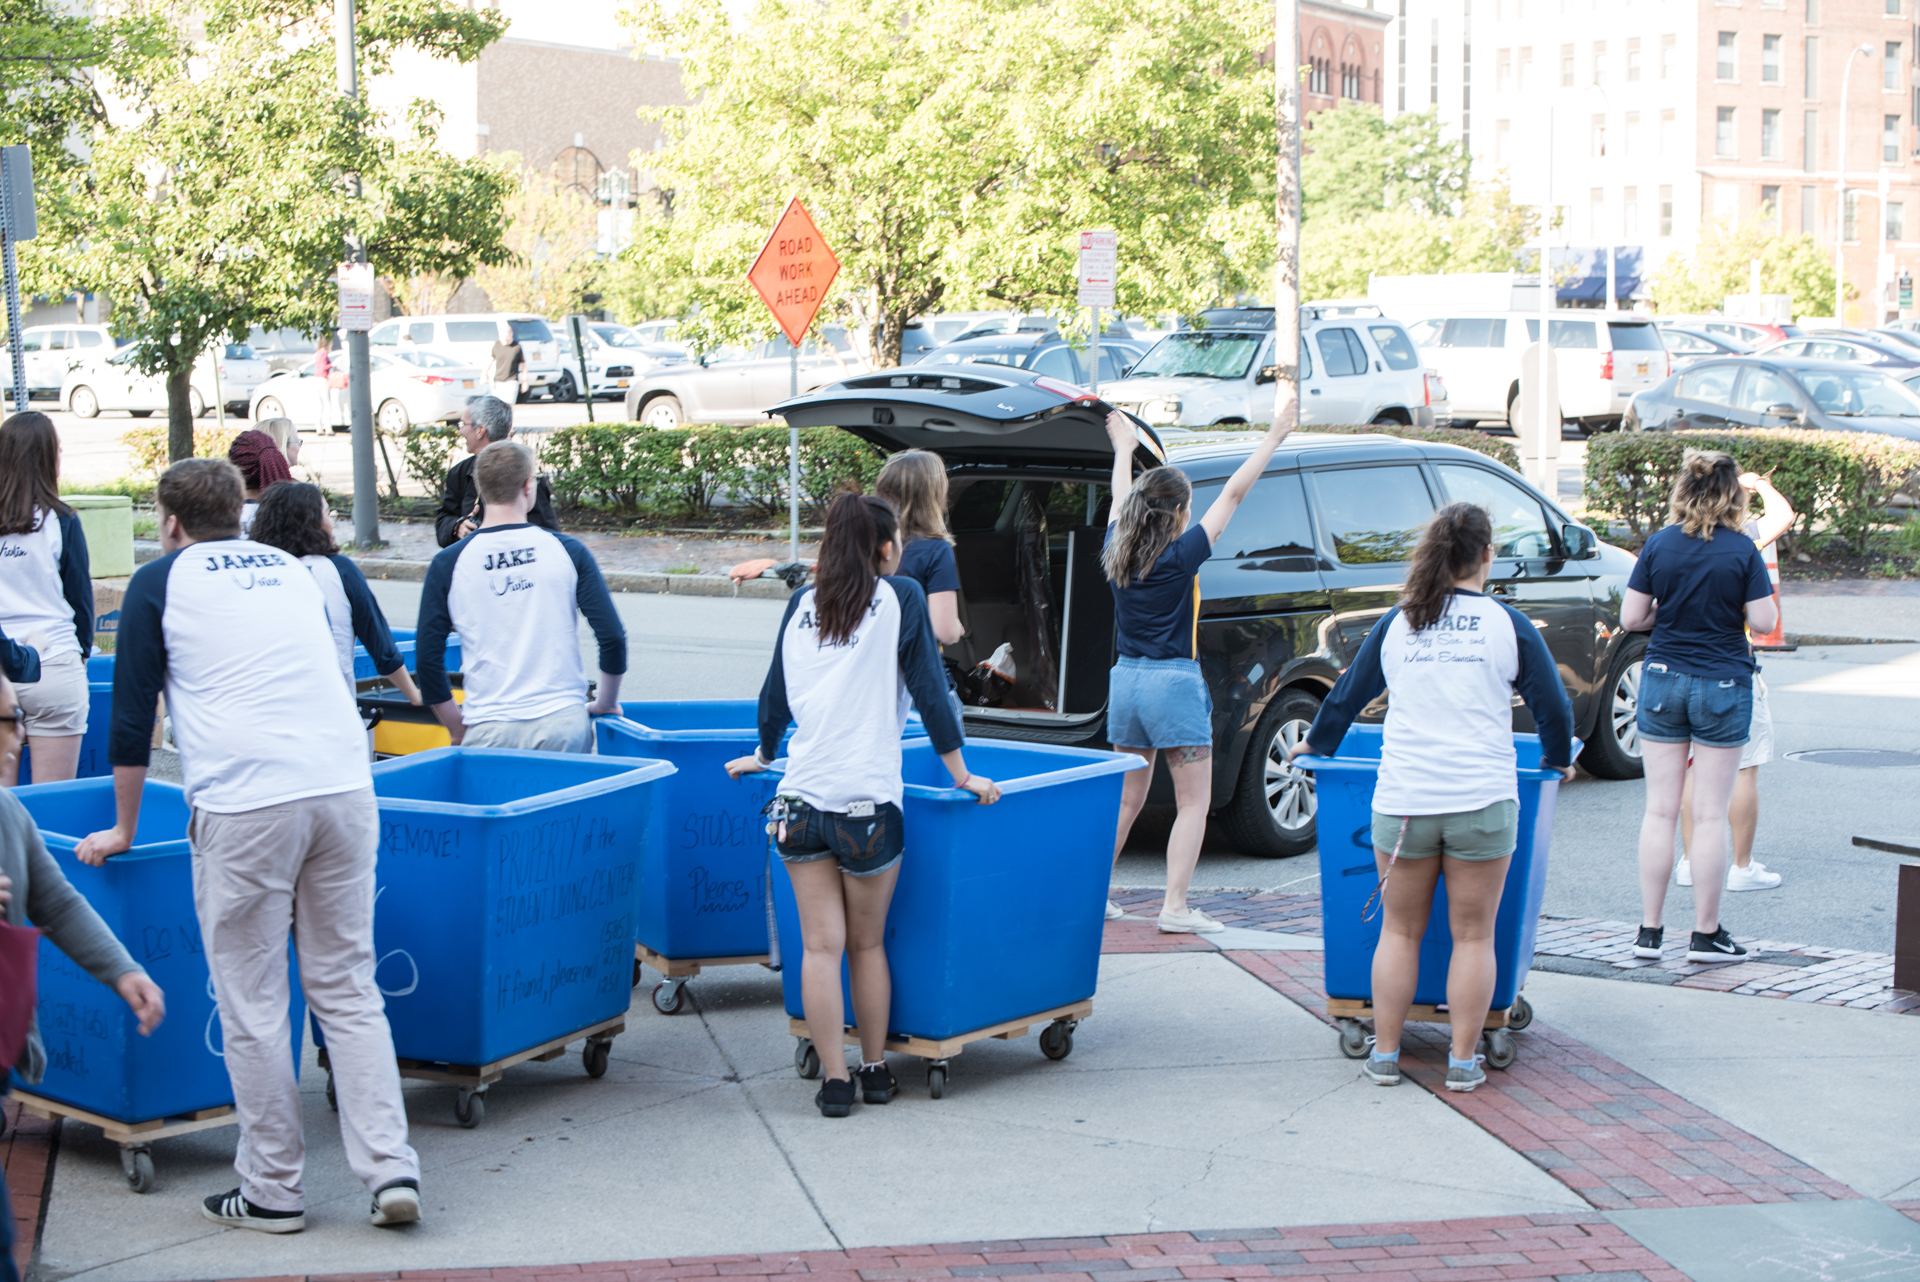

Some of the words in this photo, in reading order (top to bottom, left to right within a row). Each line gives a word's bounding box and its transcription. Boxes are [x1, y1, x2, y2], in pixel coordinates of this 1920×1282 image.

[780, 237, 812, 257] ROAD
[779, 262, 813, 281] WORK
[776, 286, 818, 307] AHEAD
[206, 554, 286, 571] JAMES
[484, 547, 536, 570] JAKE
[382, 821, 460, 858] REMOVE!
[681, 810, 768, 850] STUDENT
[500, 813, 581, 893] PROPERTY
[597, 816, 617, 851] the
[496, 887, 549, 937] STUDENT
[588, 861, 636, 911] CENTER
[143, 926, 171, 959] DO
